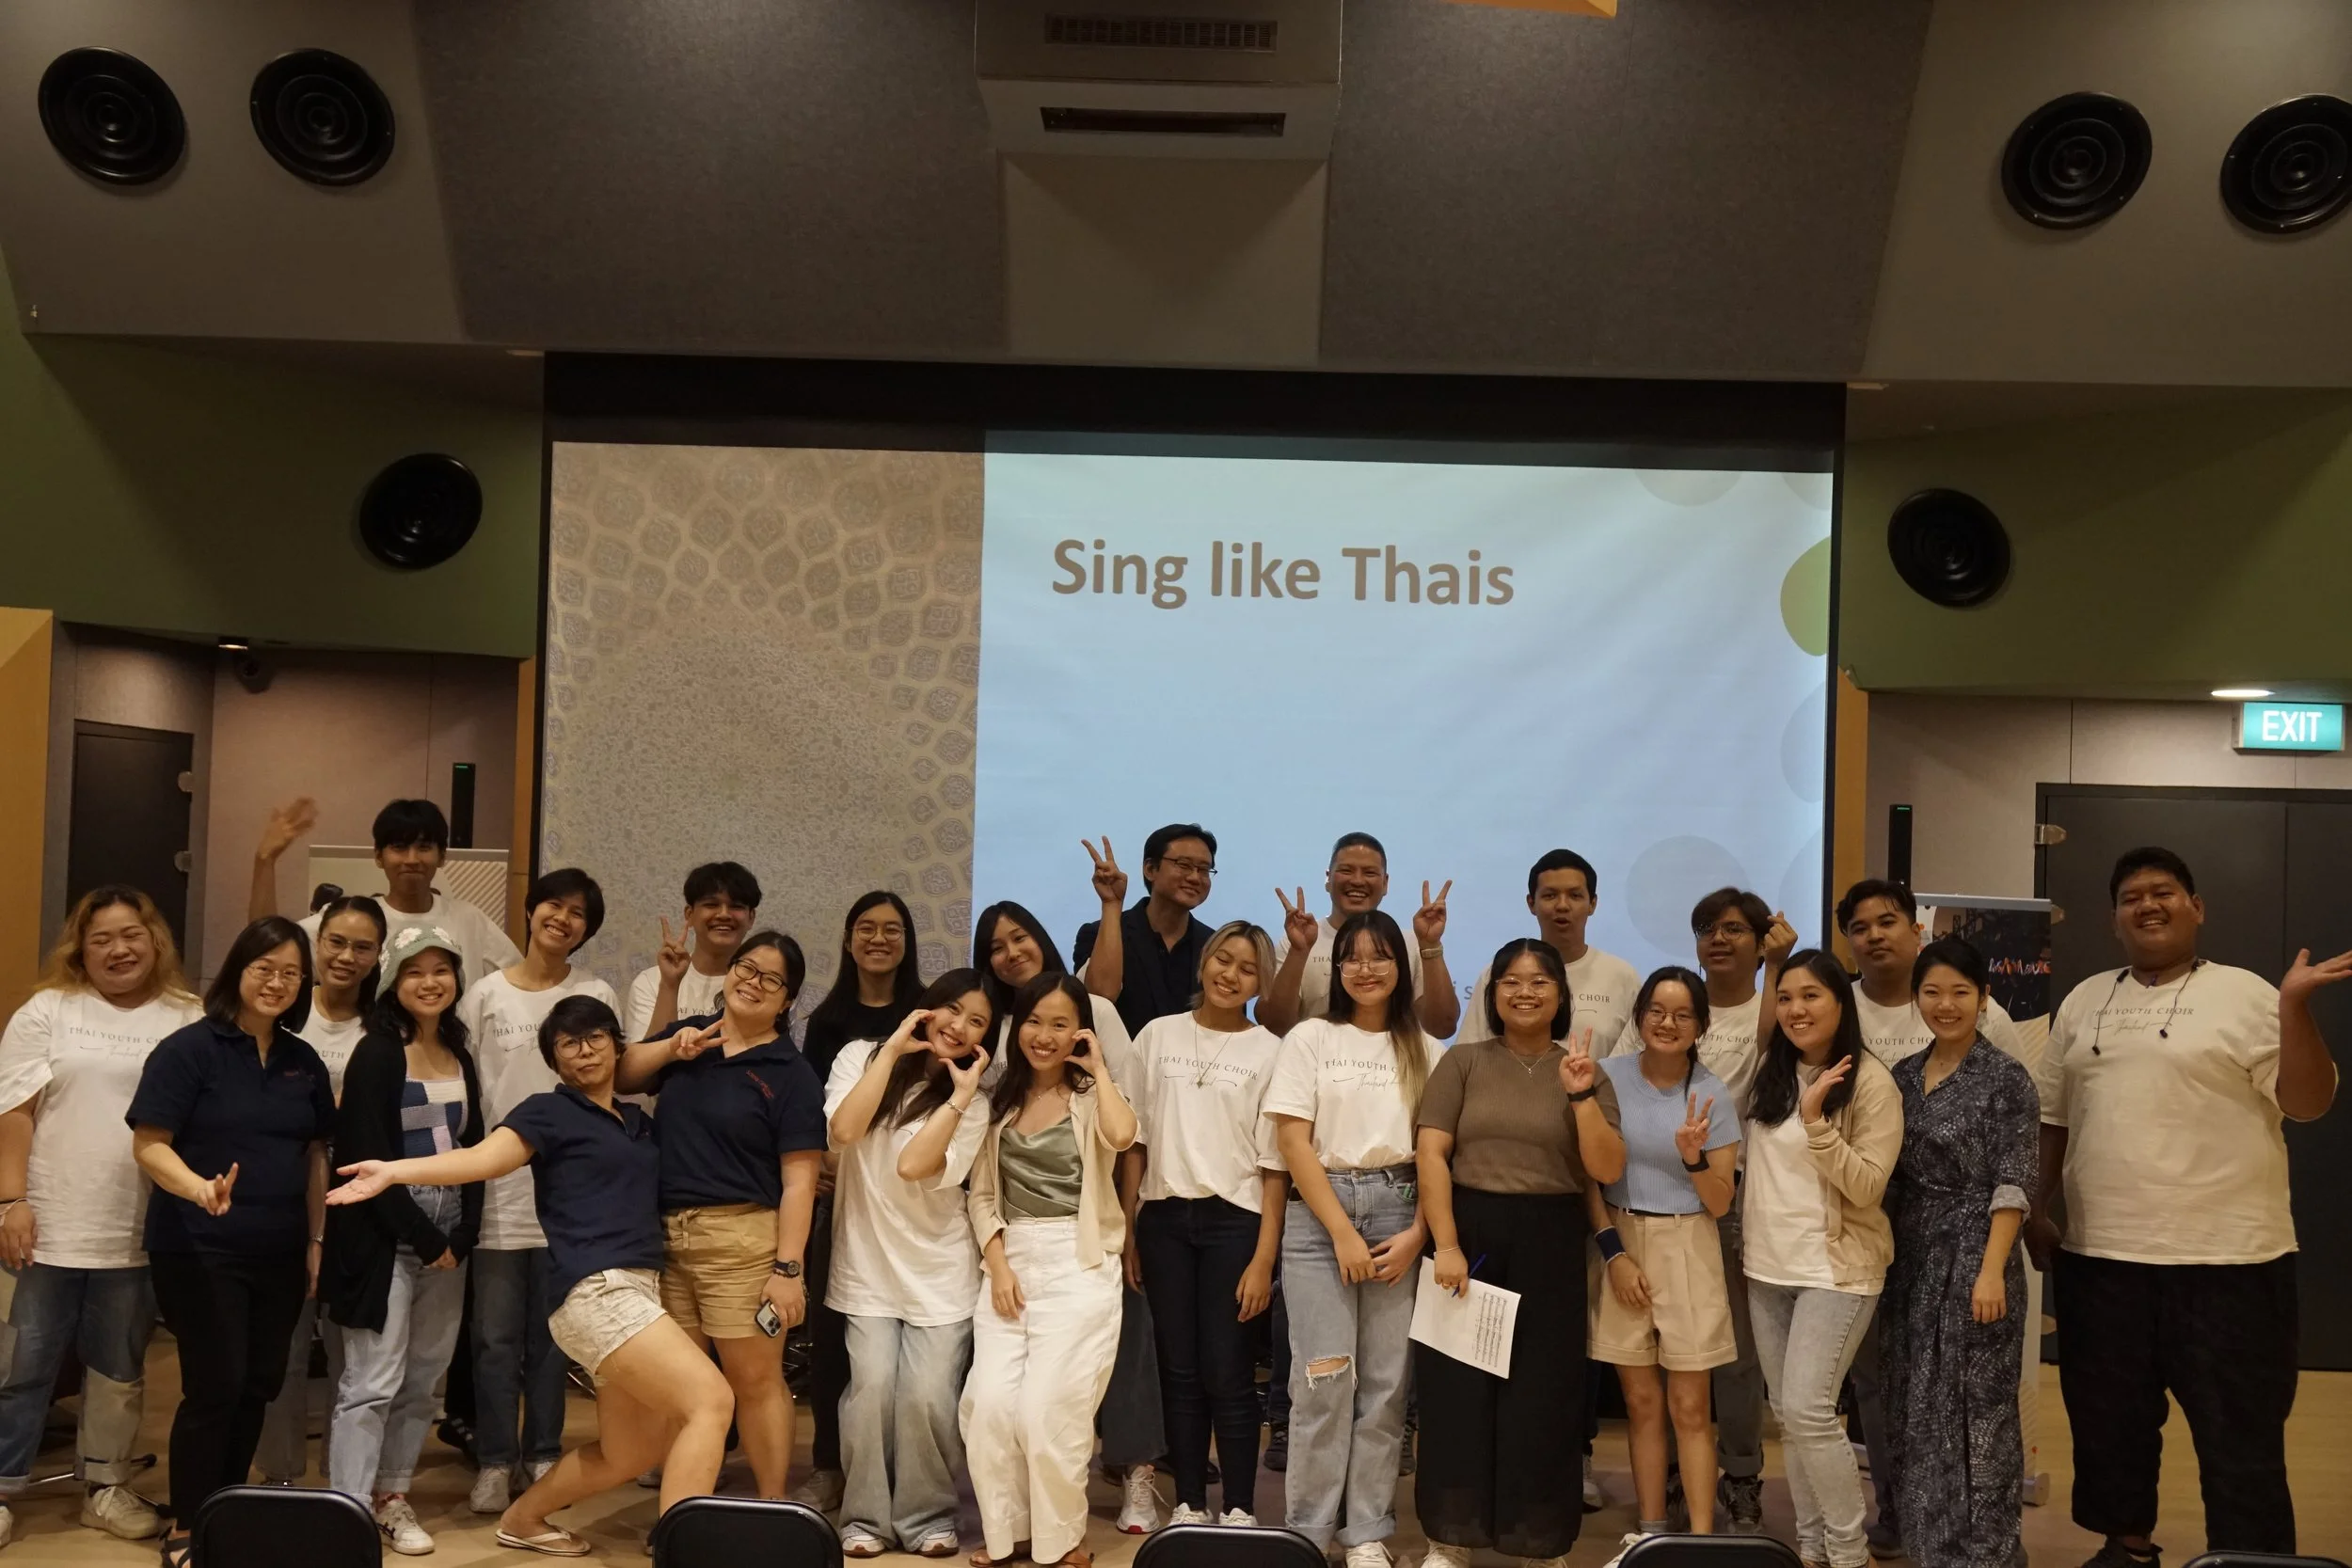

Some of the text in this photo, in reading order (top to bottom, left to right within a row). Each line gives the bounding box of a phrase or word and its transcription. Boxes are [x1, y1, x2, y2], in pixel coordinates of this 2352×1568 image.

[1052, 539, 1514, 610] Sing like Thais
[2262, 710, 2323, 742] EXIT
[1579, 993, 1610, 1003] CHOIR
[2157, 1007, 2195, 1016] CHOIR
[518, 1023, 540, 1033] YOU
[69, 1026, 96, 1037] THAI
[100, 1031, 140, 1043] YOUTH
[1868, 1037, 1904, 1046] YOUTH
[317, 1049, 344, 1059] UTH
[1159, 1056, 1258, 1081] THAI YOUTH CHOIR
[1351, 1059, 1387, 1071] YOUTH
